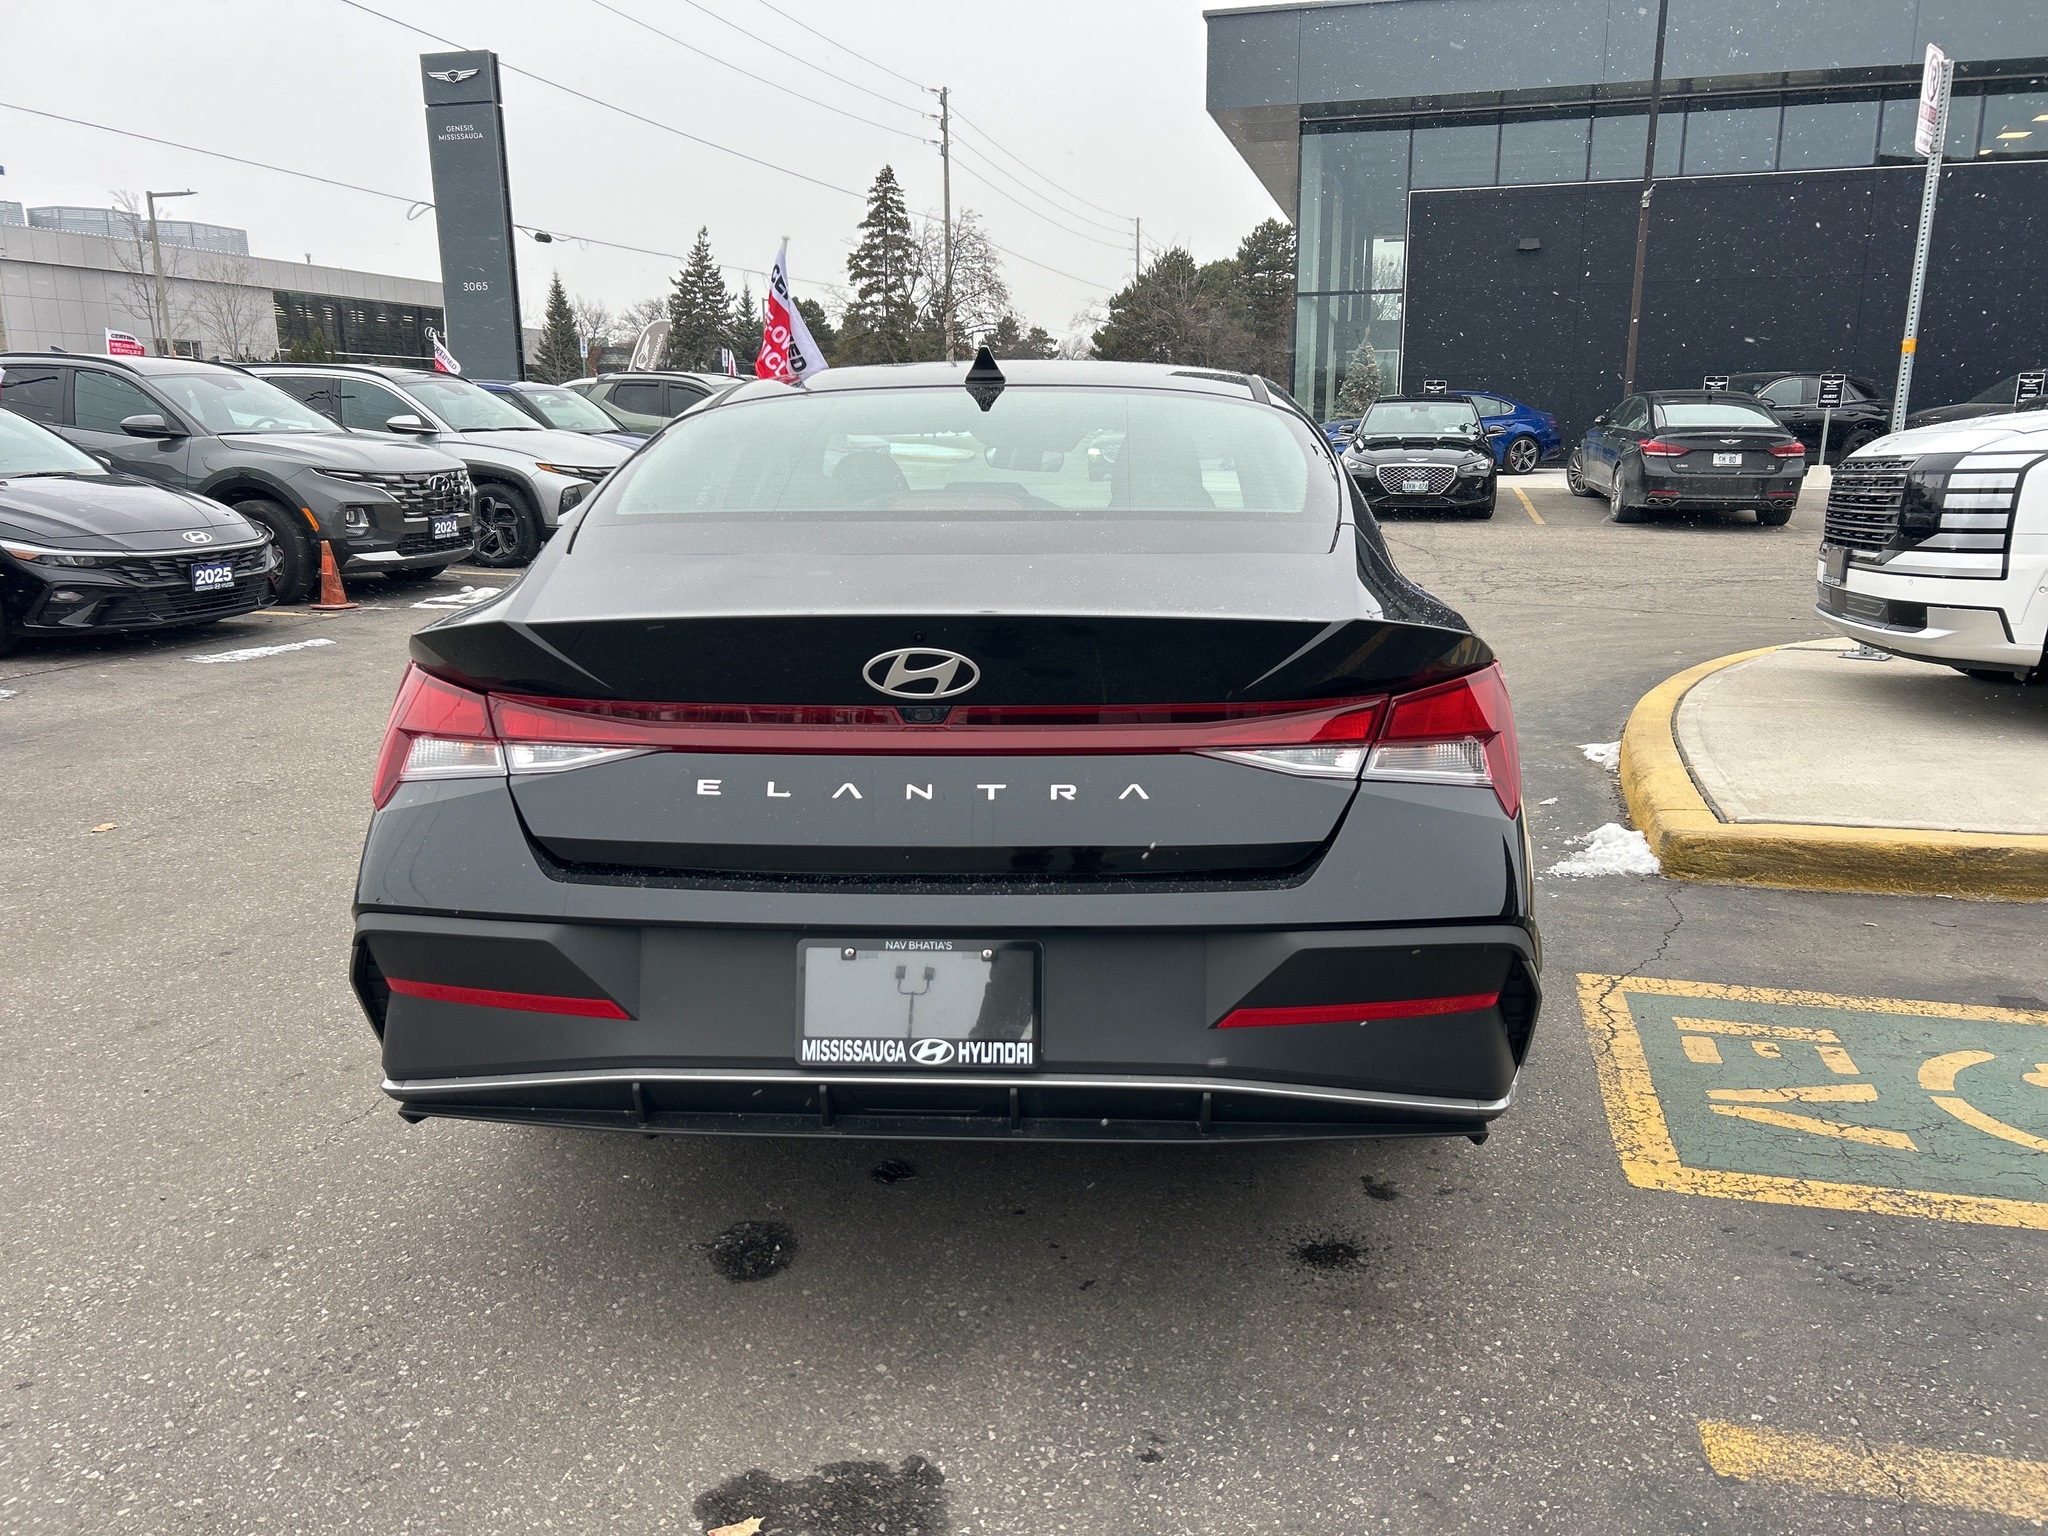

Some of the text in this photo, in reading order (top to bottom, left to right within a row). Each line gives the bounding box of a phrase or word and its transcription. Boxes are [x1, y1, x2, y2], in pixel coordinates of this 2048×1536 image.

[446, 124, 474, 132] GENESIS
[438, 132, 484, 141] MISSISSAUGA
[462, 281, 489, 292] 3065
[434, 520, 458, 534] 2024
[195, 566, 233, 585] 2025
[696, 778, 1150, 801] ELANTRA
[885, 940, 953, 950] NAV BHATIA'S
[801, 1039, 1034, 1065] MISSISSAUGA HYUNDAI
